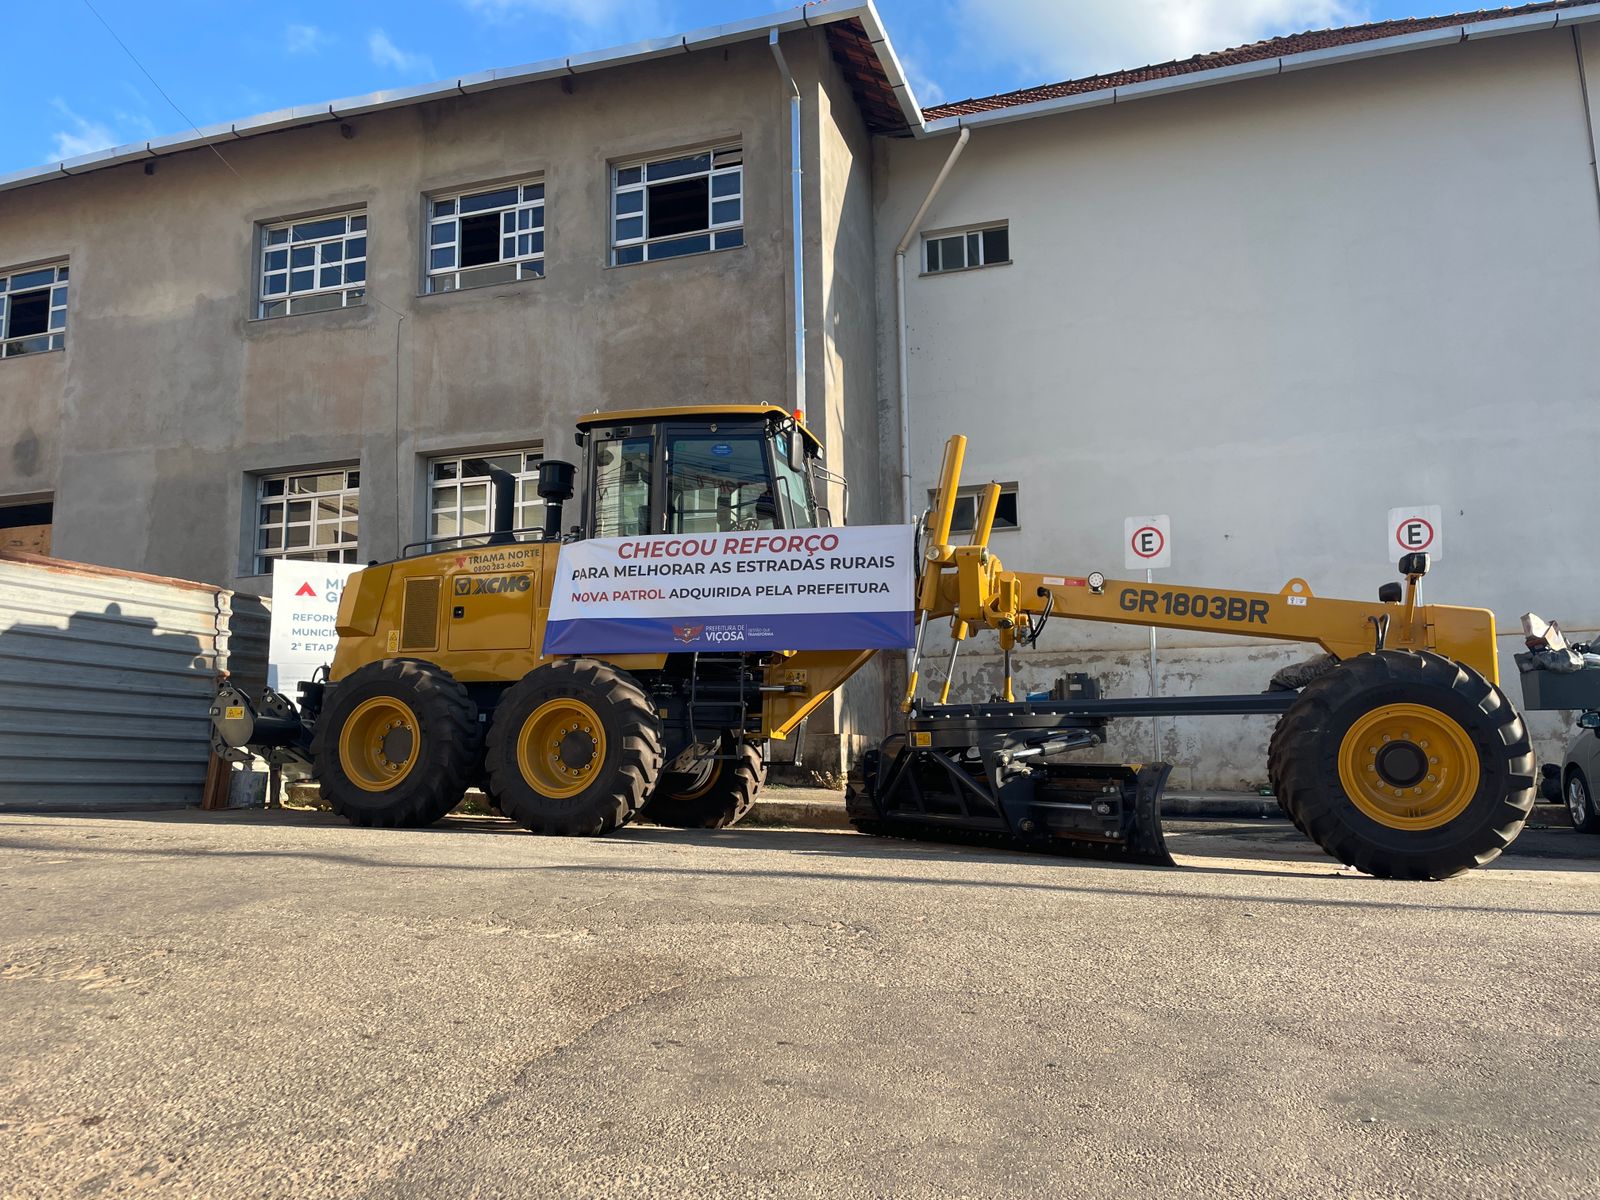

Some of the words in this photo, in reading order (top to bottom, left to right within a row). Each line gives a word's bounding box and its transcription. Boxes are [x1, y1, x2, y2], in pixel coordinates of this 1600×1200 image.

[1141, 533, 1154, 552] E
[1408, 524, 1422, 545] E
[468, 552, 505, 565] TRIAMA
[508, 548, 540, 560] NORTE
[618, 538, 717, 560] CHEGOU
[722, 534, 839, 557] REFORÇO
[473, 564, 491, 573] 0800
[492, 560, 524, 571] 283-6463
[571, 566, 609, 581] PARA
[614, 562, 706, 578] MELHORAR
[710, 561, 732, 574] AS
[736, 557, 825, 573] ESTRADAS
[830, 555, 895, 570] RURAIS
[326, 578, 345, 590] MI
[471, 575, 531, 595] XCMG
[571, 590, 609, 603] NOVA
[613, 589, 666, 601] PATROL
[669, 585, 752, 600] ADQUIRIDA
[755, 585, 793, 597] PELA
[797, 582, 890, 595] PREFEITURA
[1119, 588, 1270, 624] GR1803BR
[292, 613, 338, 623] REFORM
[292, 628, 338, 637] MUNICIP
[705, 631, 745, 643] VIÇOSA
